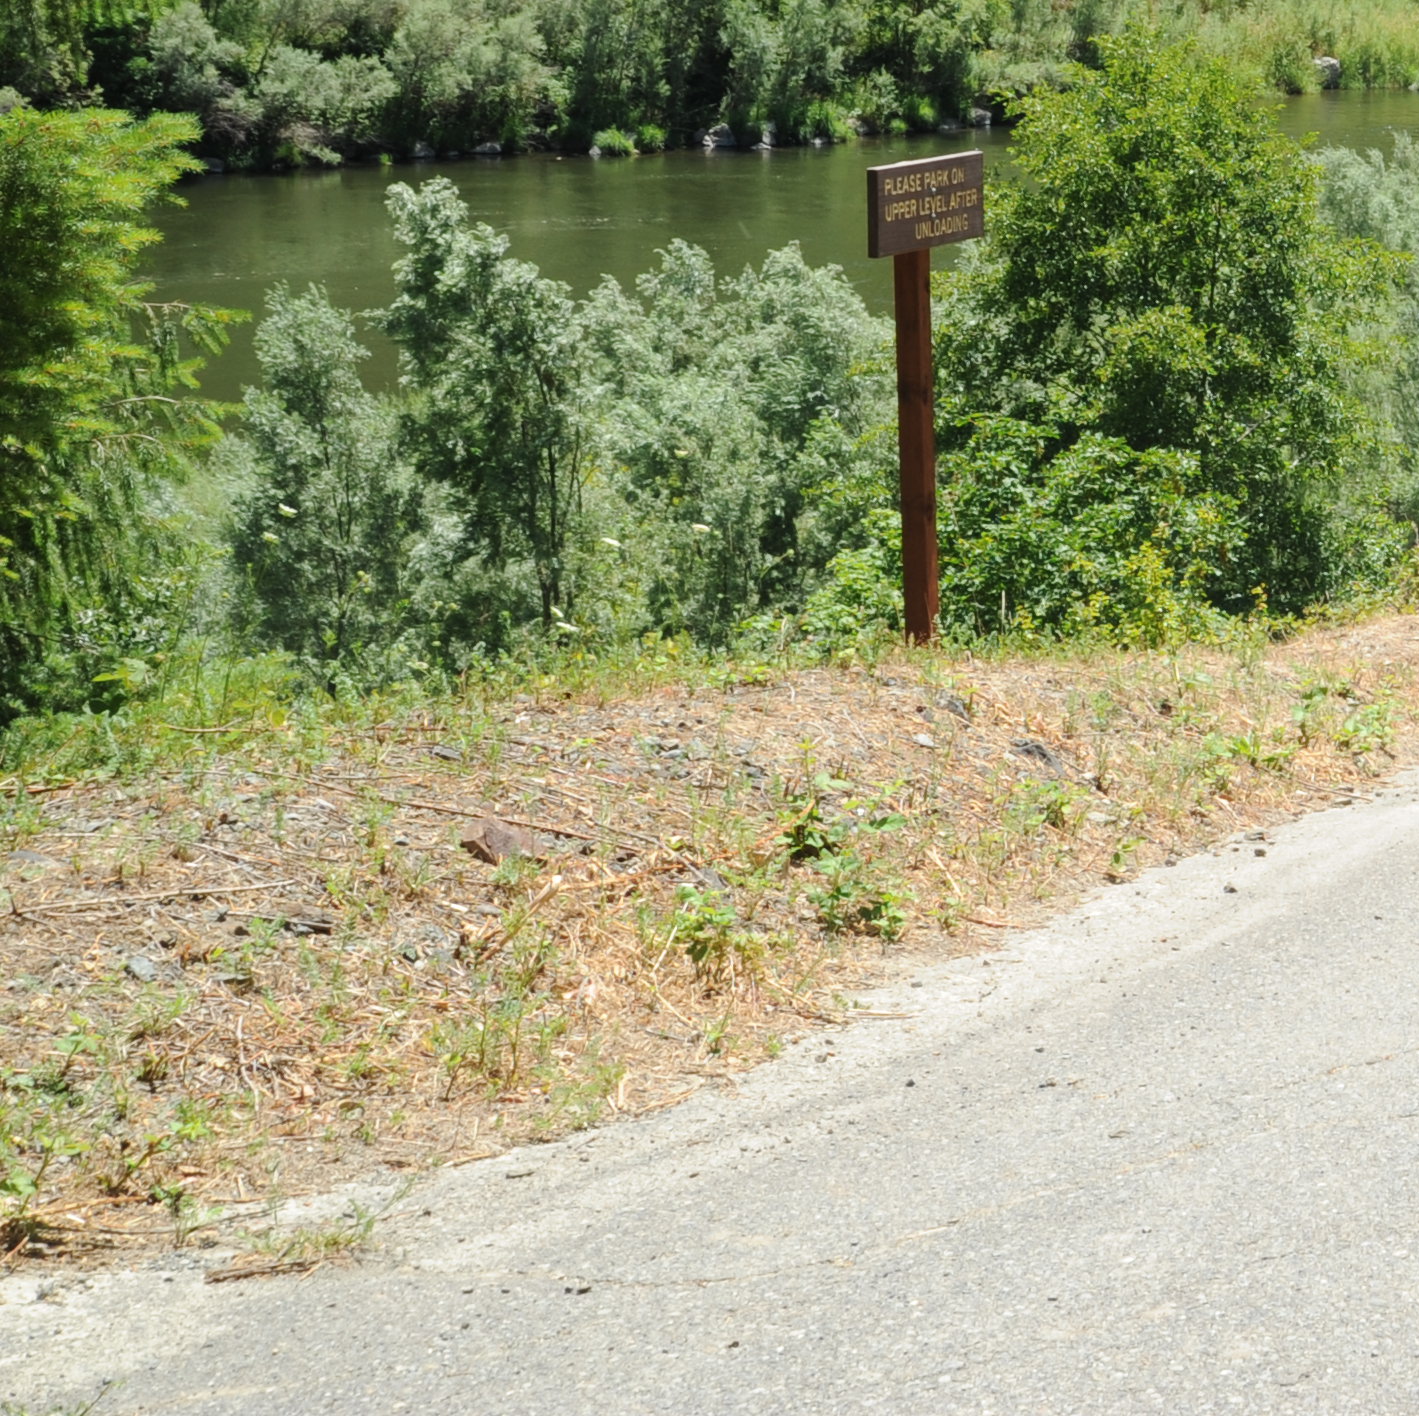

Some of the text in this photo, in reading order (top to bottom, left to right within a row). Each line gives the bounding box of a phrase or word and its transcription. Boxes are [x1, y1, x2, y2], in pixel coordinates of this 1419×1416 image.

[884, 168, 965, 196] PLEASE PARK ON
[885, 188, 977, 222] UPPER LEVEL AFTER
[915, 214, 968, 239] UNLOADING
